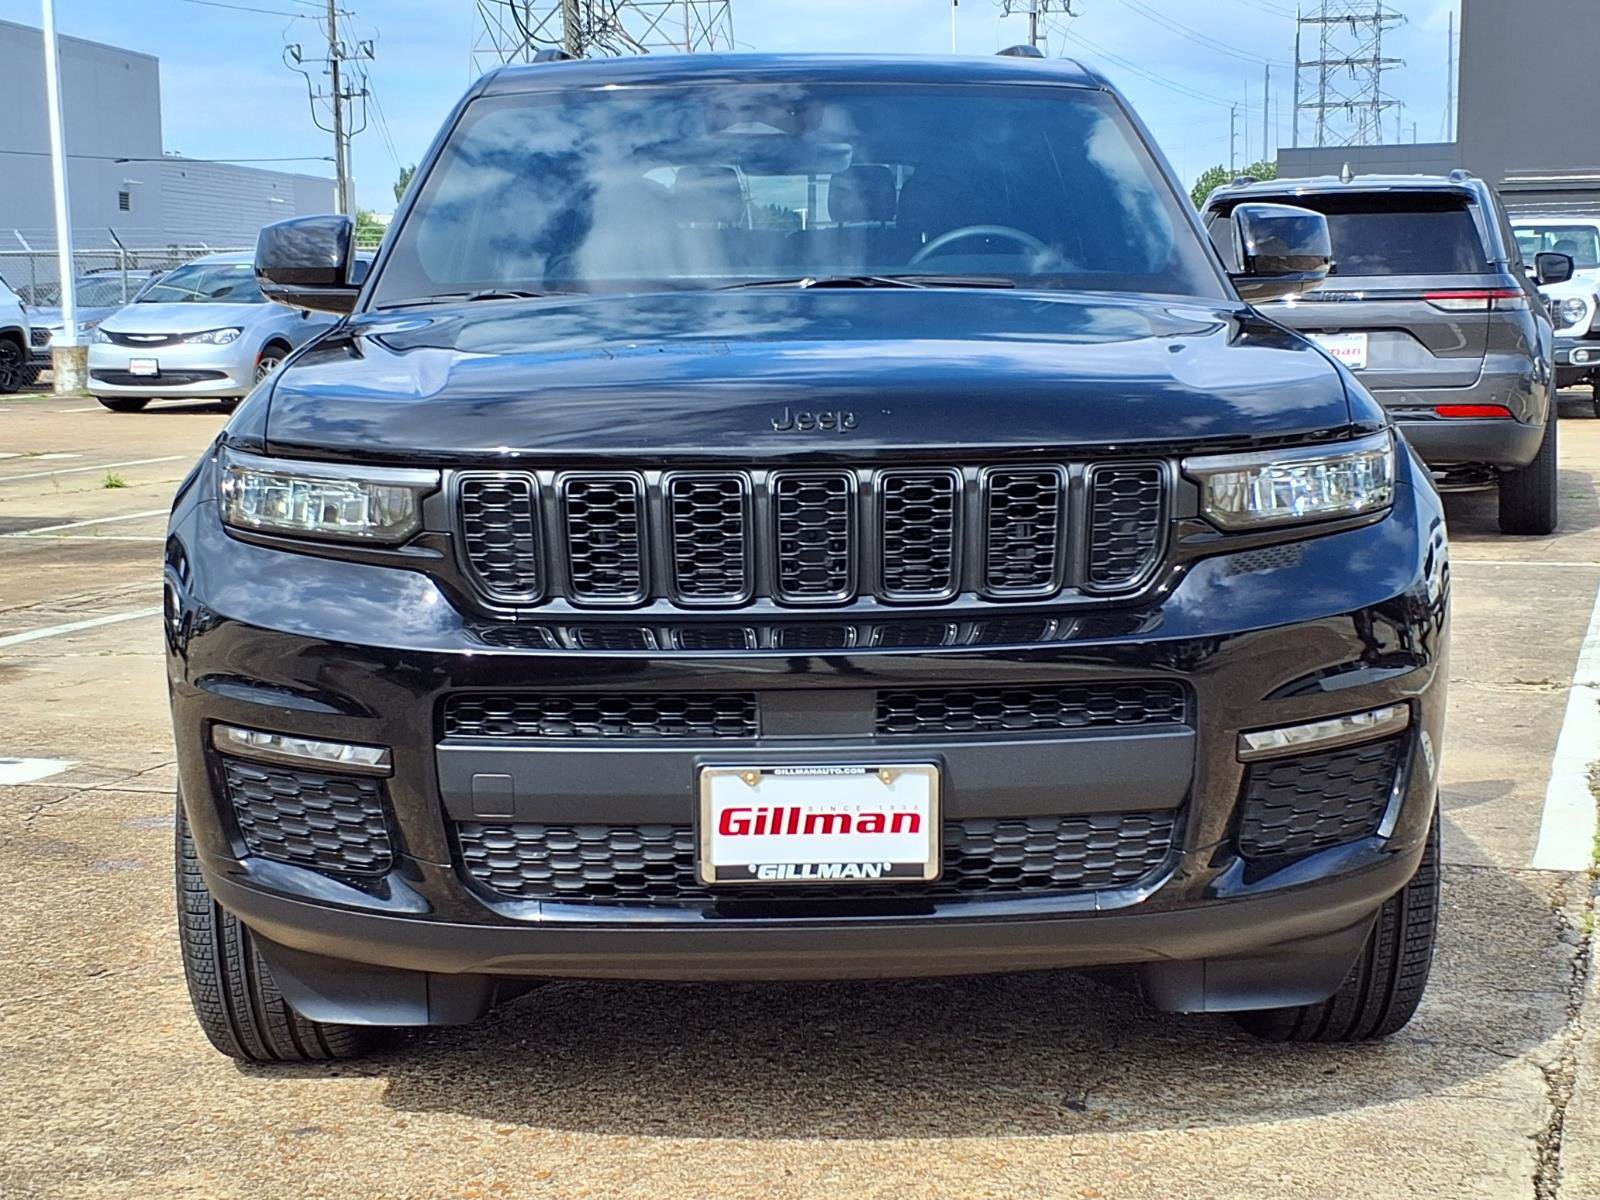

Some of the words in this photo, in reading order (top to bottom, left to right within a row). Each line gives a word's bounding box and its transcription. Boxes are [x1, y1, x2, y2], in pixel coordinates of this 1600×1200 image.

[770, 406, 858, 434] Jeep
[719, 807, 921, 836] Gillman
[757, 863, 882, 880] GILLMAN
